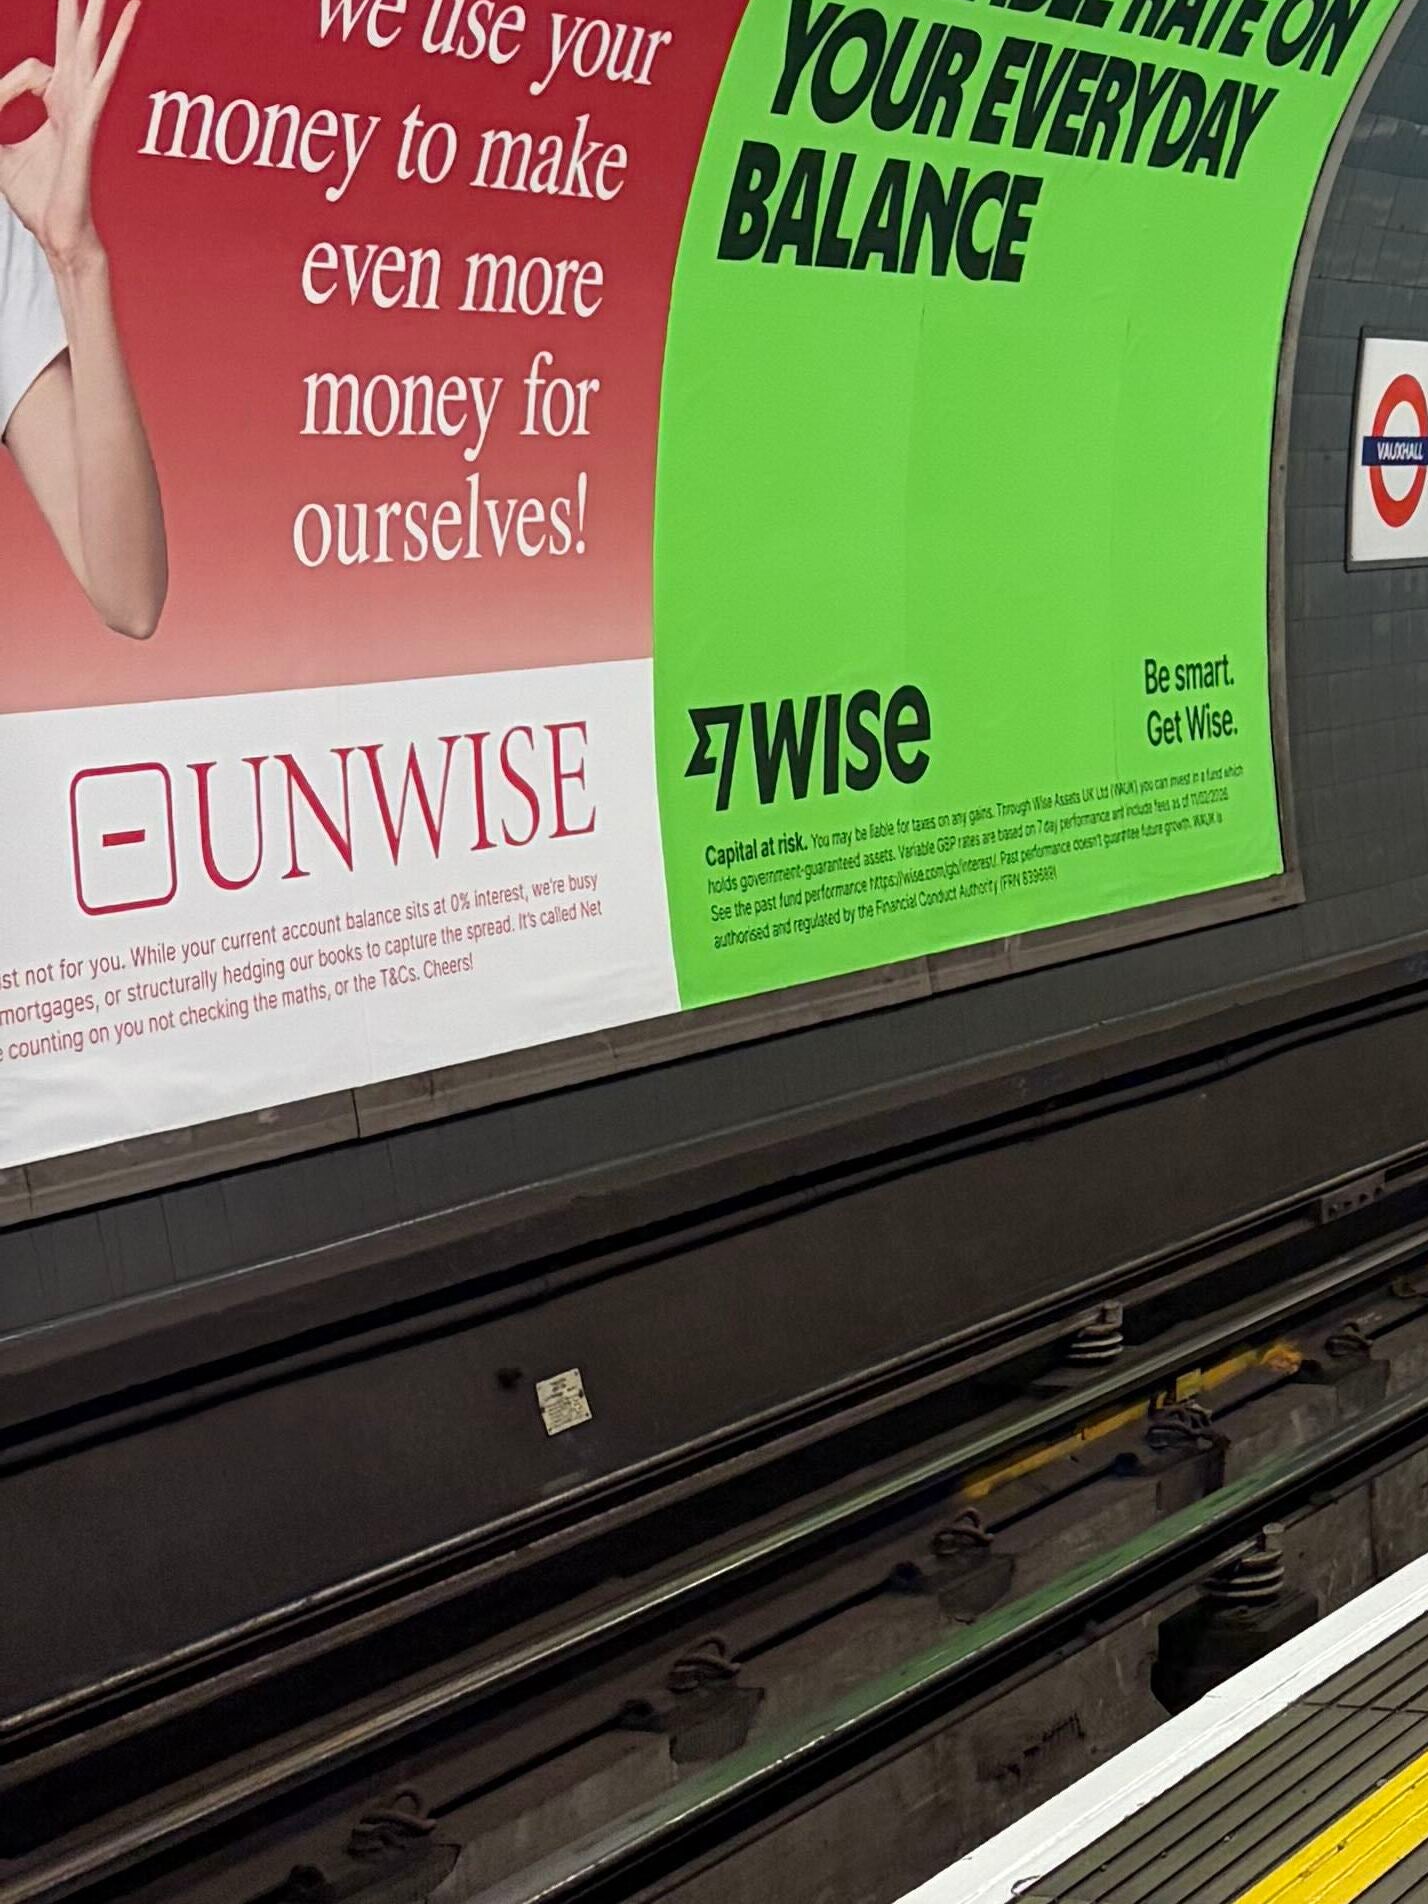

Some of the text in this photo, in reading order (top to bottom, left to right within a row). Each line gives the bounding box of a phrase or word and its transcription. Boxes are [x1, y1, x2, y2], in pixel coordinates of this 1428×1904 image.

[530, 12, 672, 95] your
[137, 89, 628, 202] money to make
[970, 36, 1278, 180] EVERYDAY
[717, 140, 1044, 282] BALANCE
[301, 241, 603, 318] even more
[300, 351, 598, 462] money for
[1377, 440, 1424, 461] VAUXHALL
[293, 472, 589, 567] ourselves!
[1144, 654, 1235, 694] Be smart.
[1146, 702, 1238, 746] Get Wise.
[187, 721, 597, 891] UNWISE
[705, 839, 757, 869] Capital
[761, 836, 774, 856] at
[777, 831, 808, 855] risk.
[810, 832, 830, 849] You
[832, 830, 852, 848] may
[855, 826, 867, 842] be
[869, 821, 895, 839] liable
[896, 817, 910, 835] for
[911, 814, 936, 831] taxes
[952, 810, 967, 829] any
[708, 874, 738, 895] holds
[863, 849, 896, 869] assets.
[711, 877, 867, 922] See the past fund performance
[0, 899, 603, 1028] mortgages, or structurally hedging our books to capture the spread. It's called Net
[25, 964, 54, 987] not
[60, 958, 83, 981] for
[89, 954, 125, 980] you.
[130, 942, 176, 968] While
[181, 937, 216, 964] your
[221, 925, 277, 953] current
[282, 915, 341, 942] account
[346, 903, 401, 930] balance
[405, 898, 430, 921] sits
[433, 897, 447, 915] at
[450, 892, 471, 913] 0%
[474, 883, 529, 907] interest,
[531, 878, 565, 897] we're
[569, 873, 598, 894] busy
[714, 923, 770, 949] authorised
[772, 918, 792, 939] and
[793, 907, 840, 935] regulated
[843, 904, 856, 924] by
[858, 901, 874, 919] the
[875, 893, 918, 915] Financial
[8, 1030, 84, 1061] counting
[89, 1025, 110, 1045] on
[114, 1019, 144, 1045] you
[149, 1012, 175, 1034] not
[179, 996, 249, 1027] checking
[253, 993, 278, 1013] the
[282, 981, 332, 1006] maths,
[334, 979, 349, 997] or
[354, 972, 376, 993] the
[380, 963, 420, 989] T&Cs.
[423, 952, 474, 979] Cheers!
